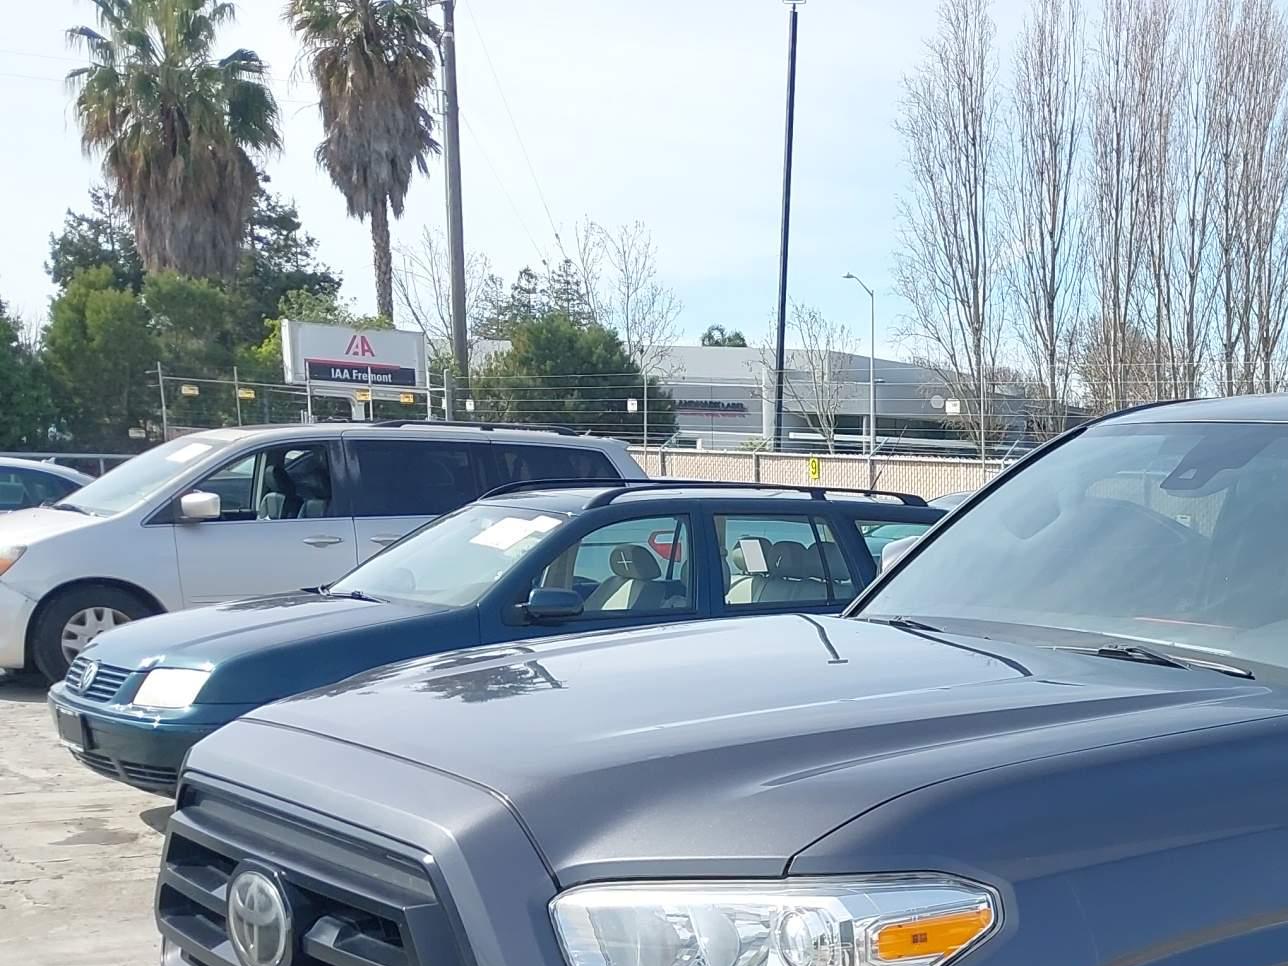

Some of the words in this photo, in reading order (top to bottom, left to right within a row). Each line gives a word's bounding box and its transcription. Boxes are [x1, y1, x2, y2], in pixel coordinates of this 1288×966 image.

[331, 368, 350, 380] IAA
[352, 369, 392, 383] Fremont
[811, 459, 817, 475] 9
